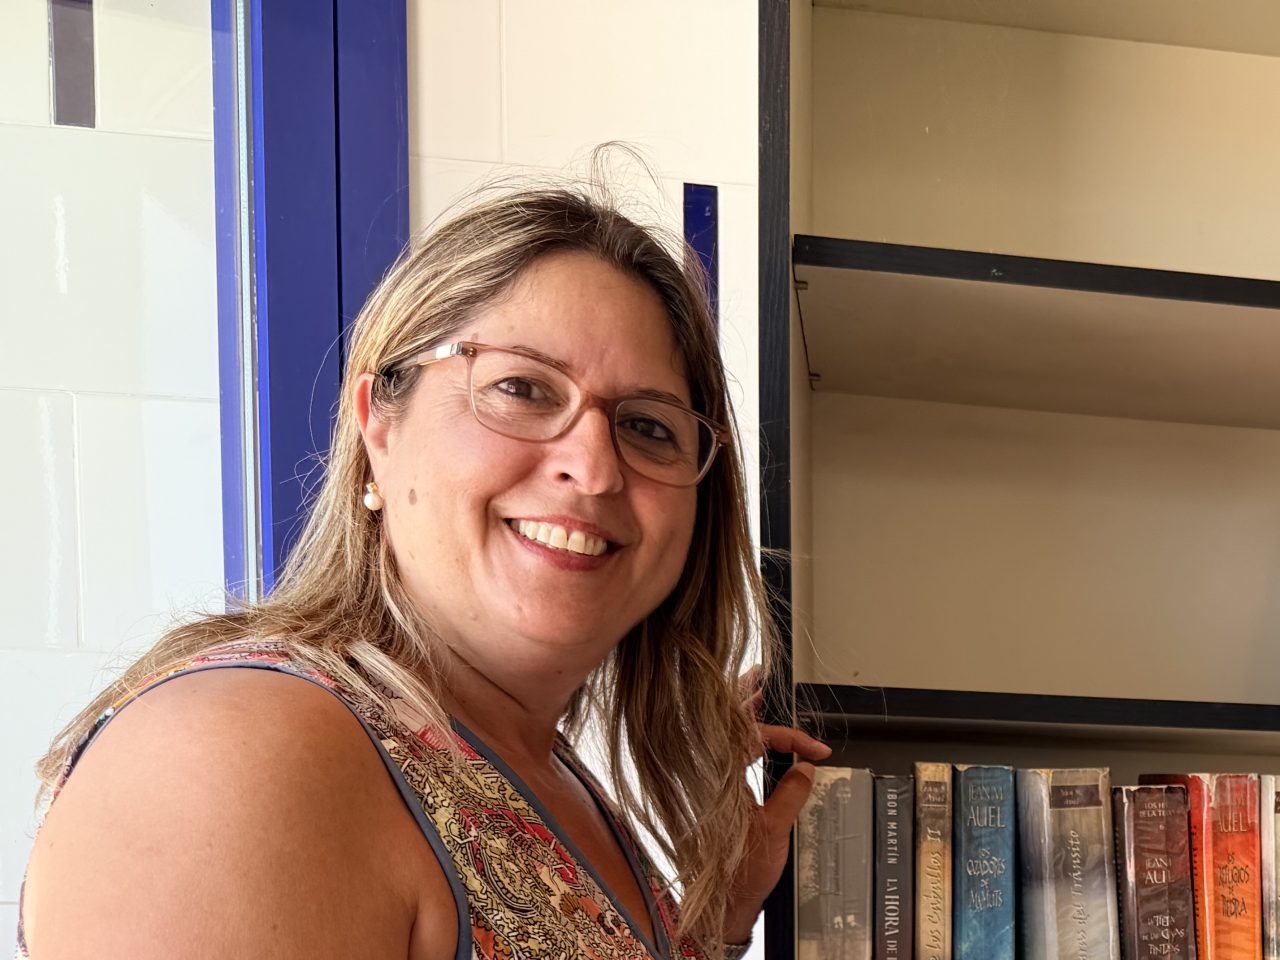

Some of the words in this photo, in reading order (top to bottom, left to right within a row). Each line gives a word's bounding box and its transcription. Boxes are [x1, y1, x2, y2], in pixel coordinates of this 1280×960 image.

[886, 789, 897, 816] IBON
[967, 806, 1005, 827] AUEL
[886, 821, 898, 864] MARTÍN
[1068, 829, 1081, 895] Tránsito
[886, 878, 896, 891] LA
[923, 851, 942, 924] Caballos
[884, 894, 899, 935] HORA
[886, 940, 896, 954] DE
[927, 928, 941, 950] los
